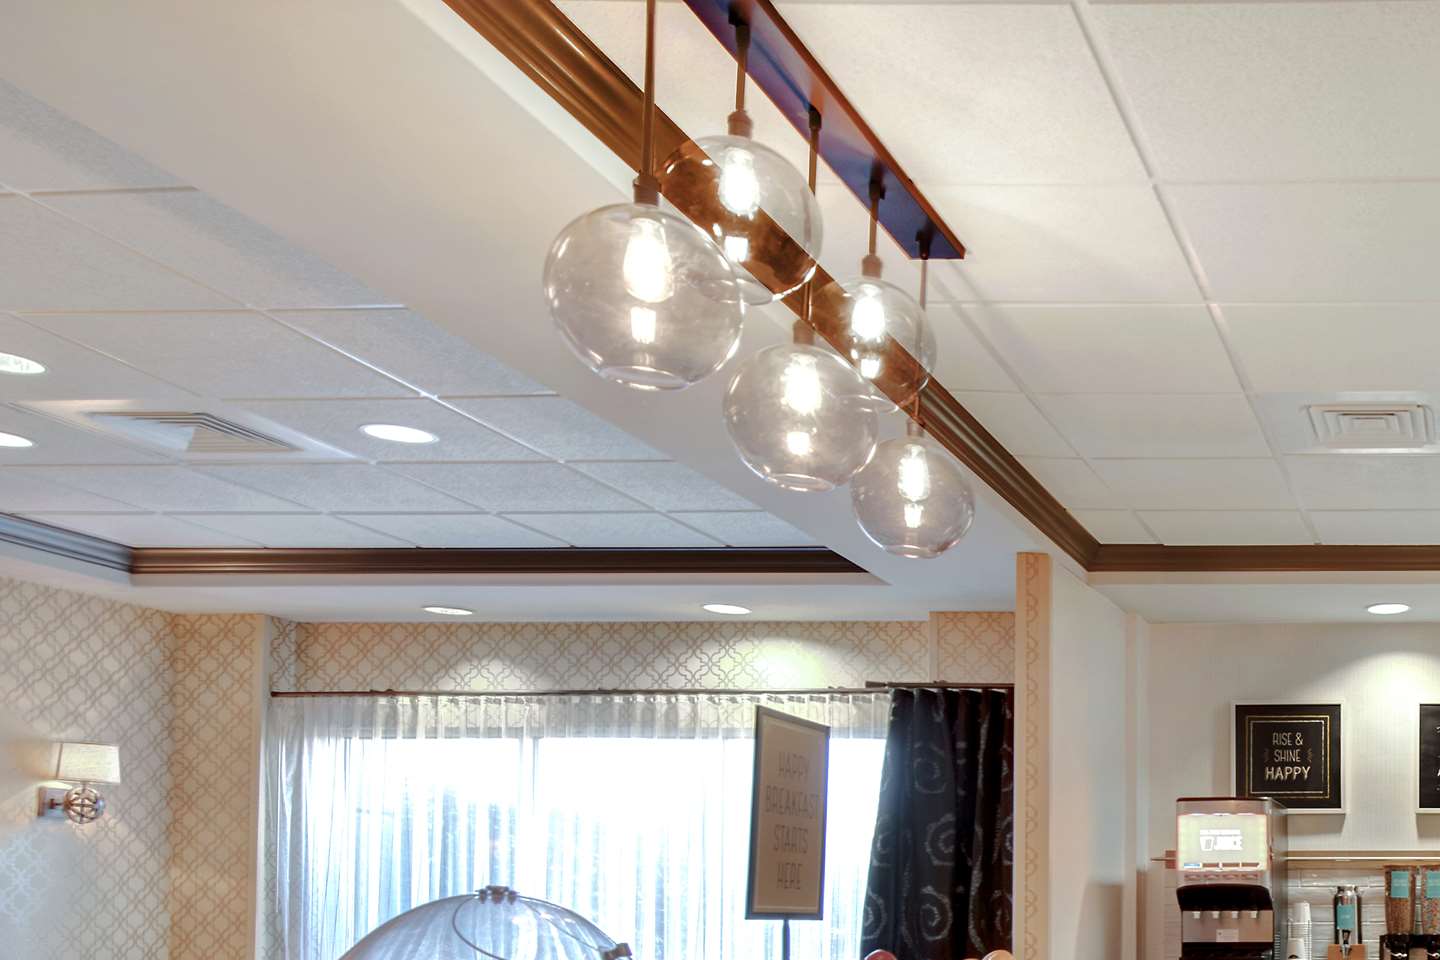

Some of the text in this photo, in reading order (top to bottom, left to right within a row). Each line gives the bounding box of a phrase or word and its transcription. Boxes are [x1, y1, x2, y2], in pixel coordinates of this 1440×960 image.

[1272, 732, 1304, 746] RISE &
[778, 751, 810, 783] HAPPY
[1273, 748, 1301, 763] SHINE
[1264, 766, 1311, 780] HAPPY
[765, 785, 821, 820] BREAKFAST
[773, 824, 809, 854] STARTS
[776, 862, 803, 891] HERE
